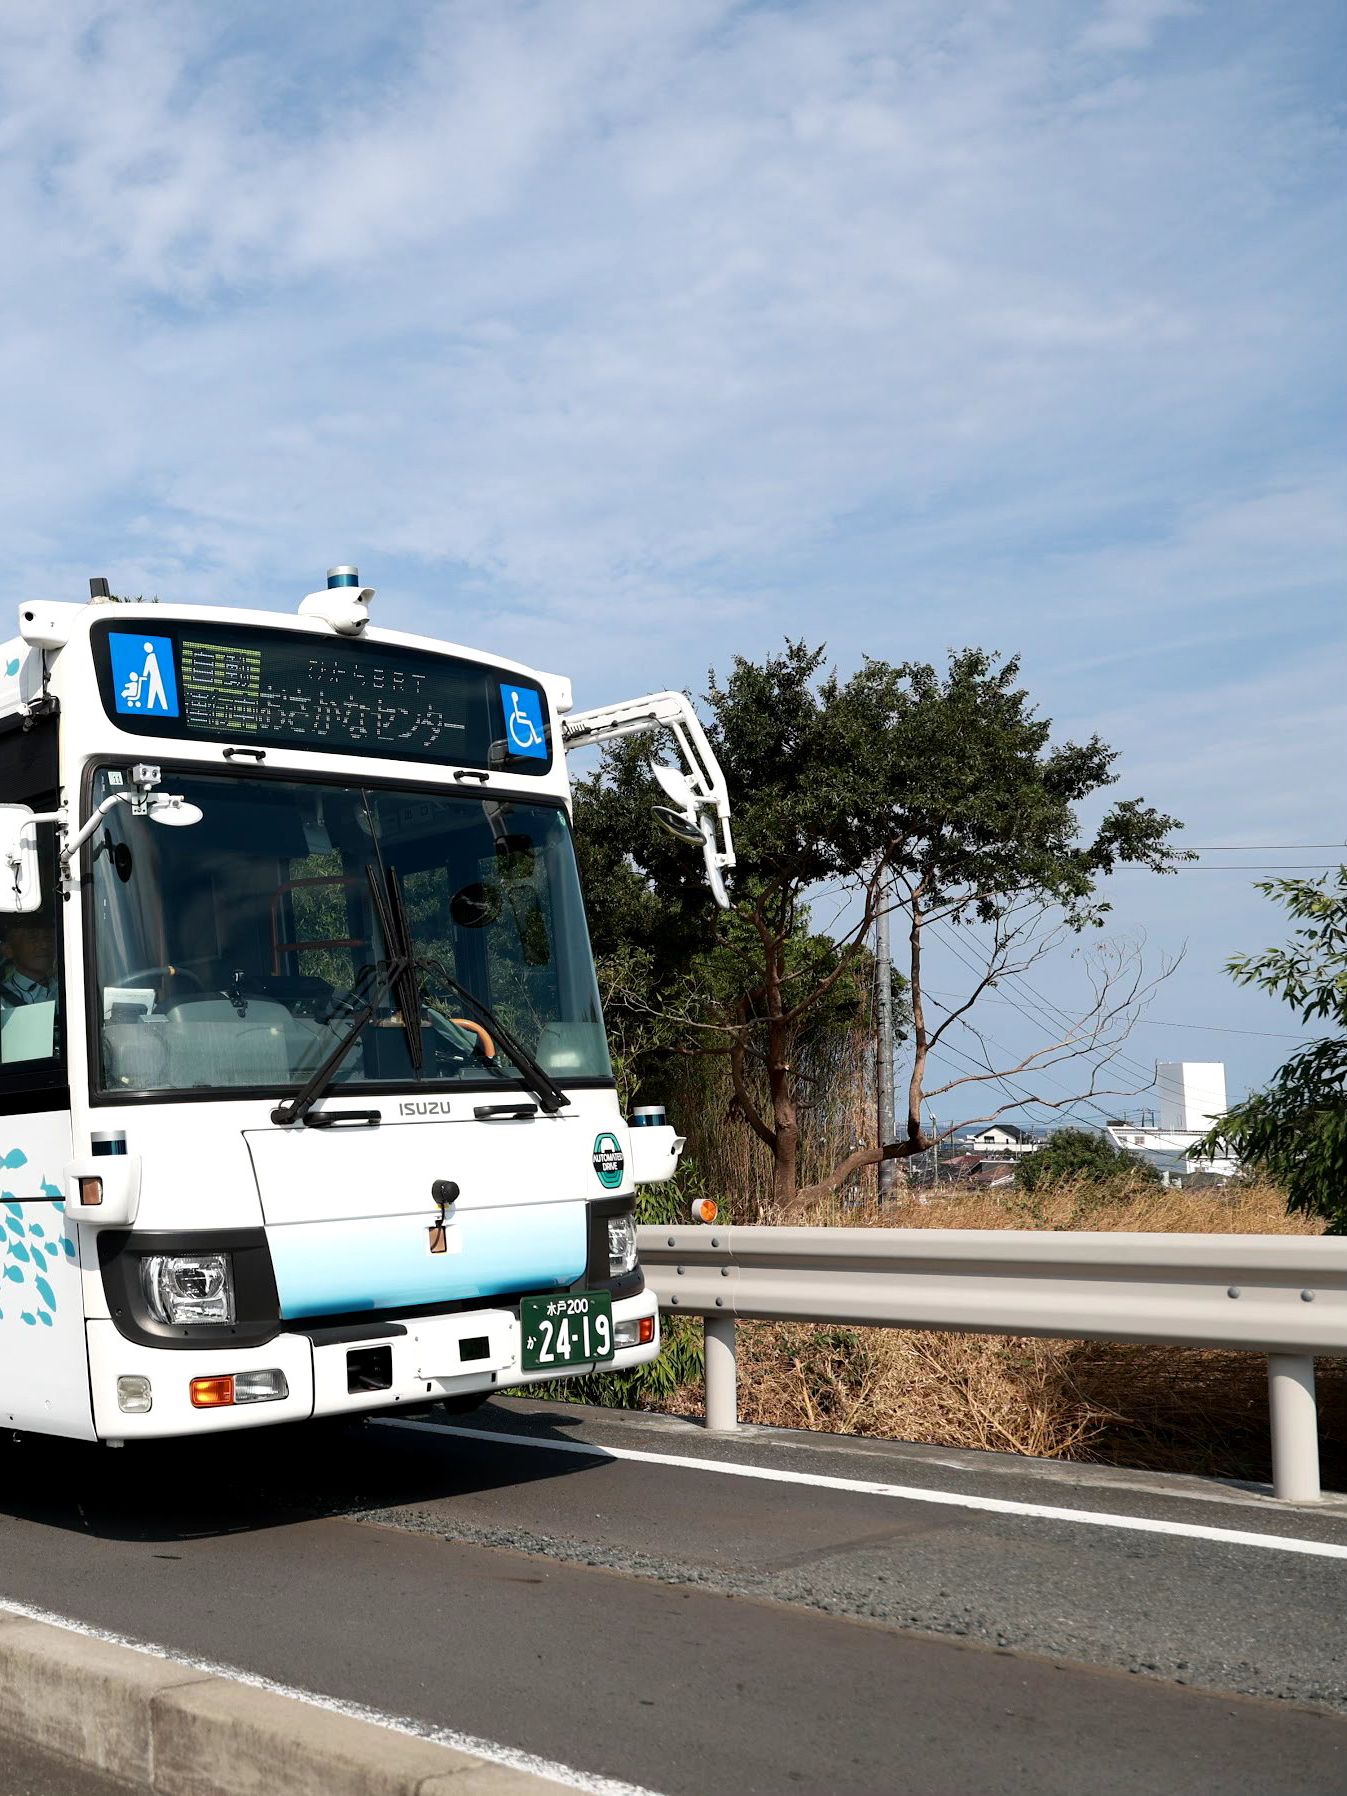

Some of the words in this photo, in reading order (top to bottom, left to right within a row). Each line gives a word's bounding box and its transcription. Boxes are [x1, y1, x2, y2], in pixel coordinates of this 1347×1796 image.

[399, 1101, 451, 1116] ISUZU
[593, 1152, 623, 1163] AUTOMATED
[602, 1161, 619, 1172] DRIVE
[546, 1298, 589, 1316] 水戸200
[526, 1335, 537, 1351] か
[538, 1313, 612, 1363] 24-19
